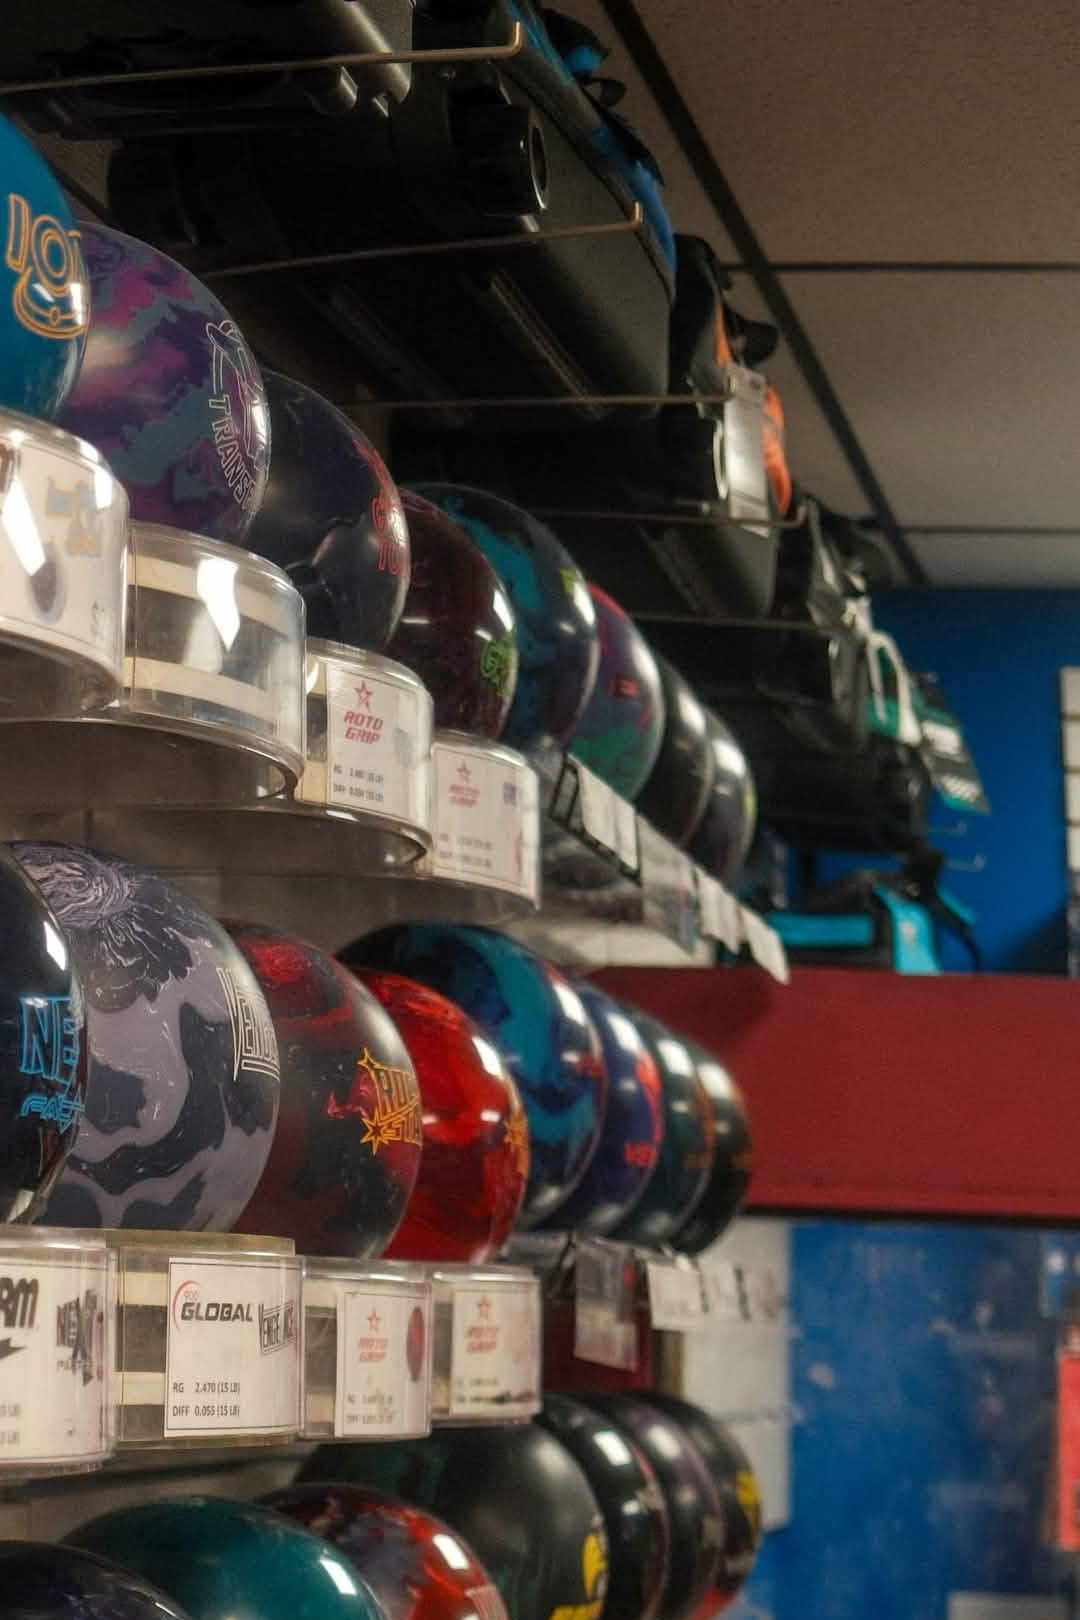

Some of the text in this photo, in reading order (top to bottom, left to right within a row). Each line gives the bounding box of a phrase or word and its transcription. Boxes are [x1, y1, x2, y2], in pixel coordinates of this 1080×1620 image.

[181, 1302, 253, 1323] GLOBAL
[172, 1381, 185, 1394] RG
[194, 1381, 217, 1395] 2.470
[172, 1405, 190, 1418] DIFF
[193, 1405, 216, 1418] 0.055
